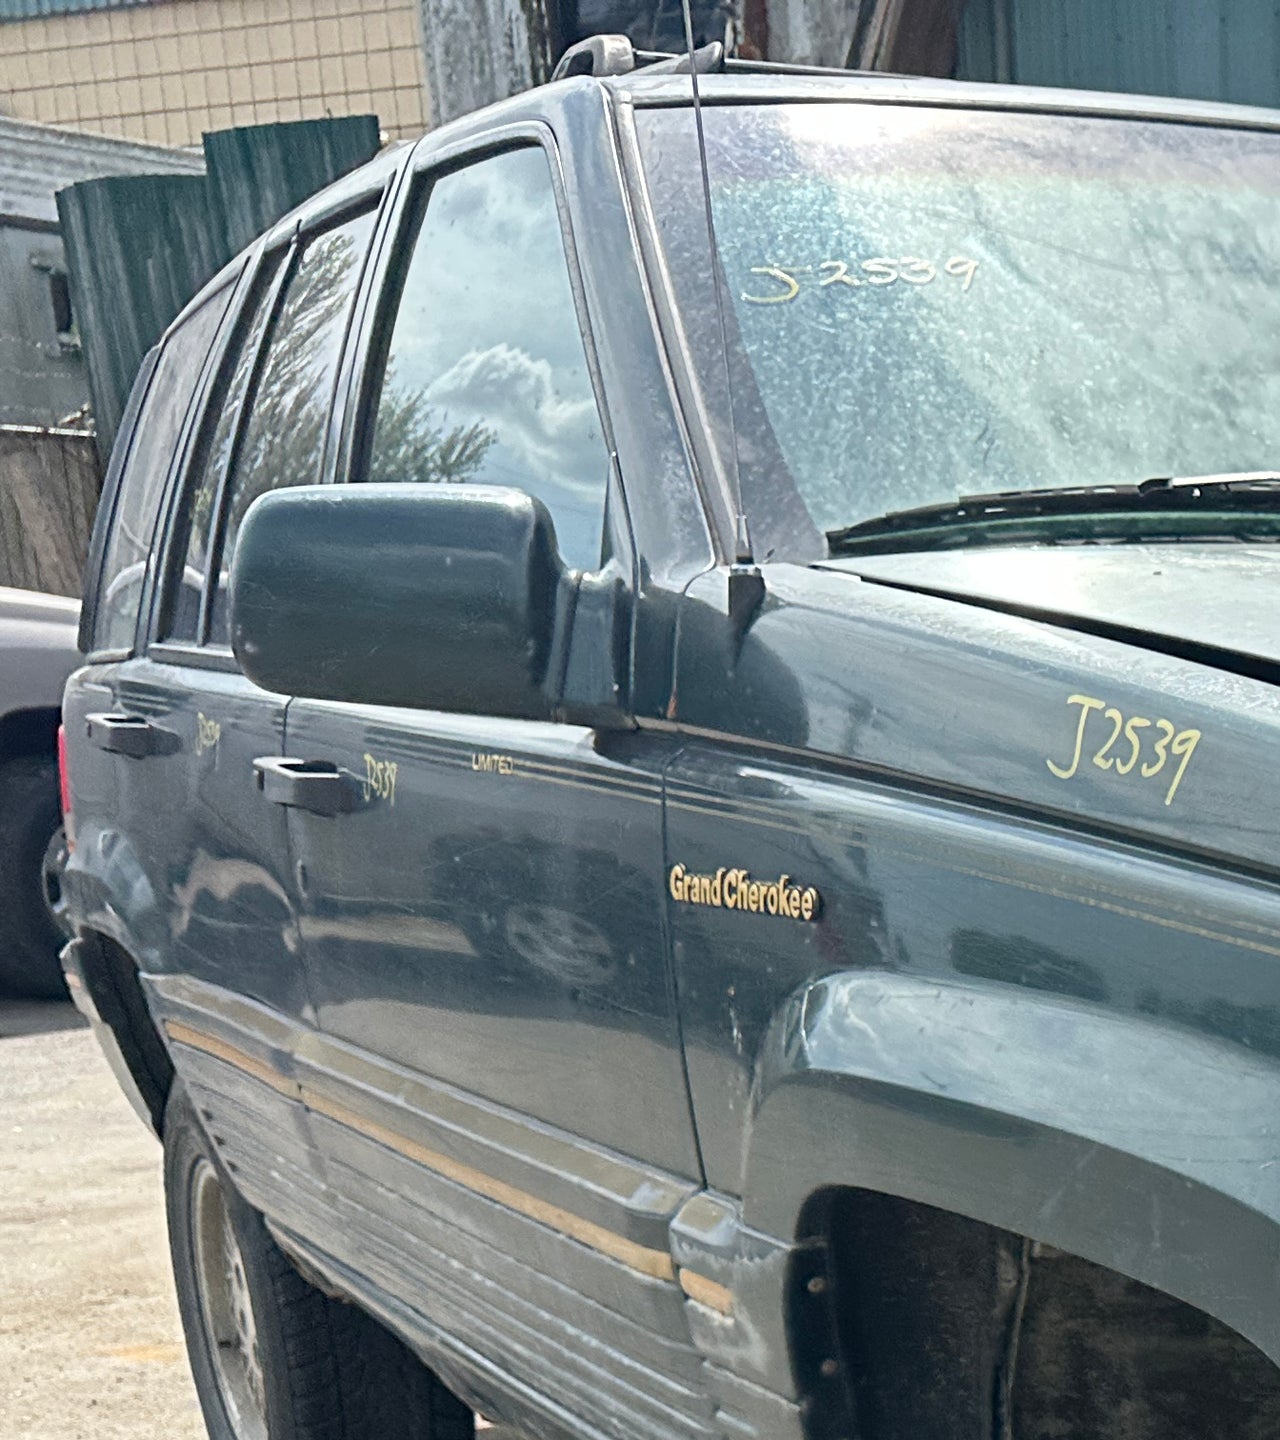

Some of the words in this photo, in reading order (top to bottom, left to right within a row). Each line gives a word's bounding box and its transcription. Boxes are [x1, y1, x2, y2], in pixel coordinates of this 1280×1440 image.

[363, 752, 398, 807] J2539
[1046, 694, 1202, 806] J2539
[669, 862, 726, 907] Grand
[722, 868, 818, 921] Cherokee
